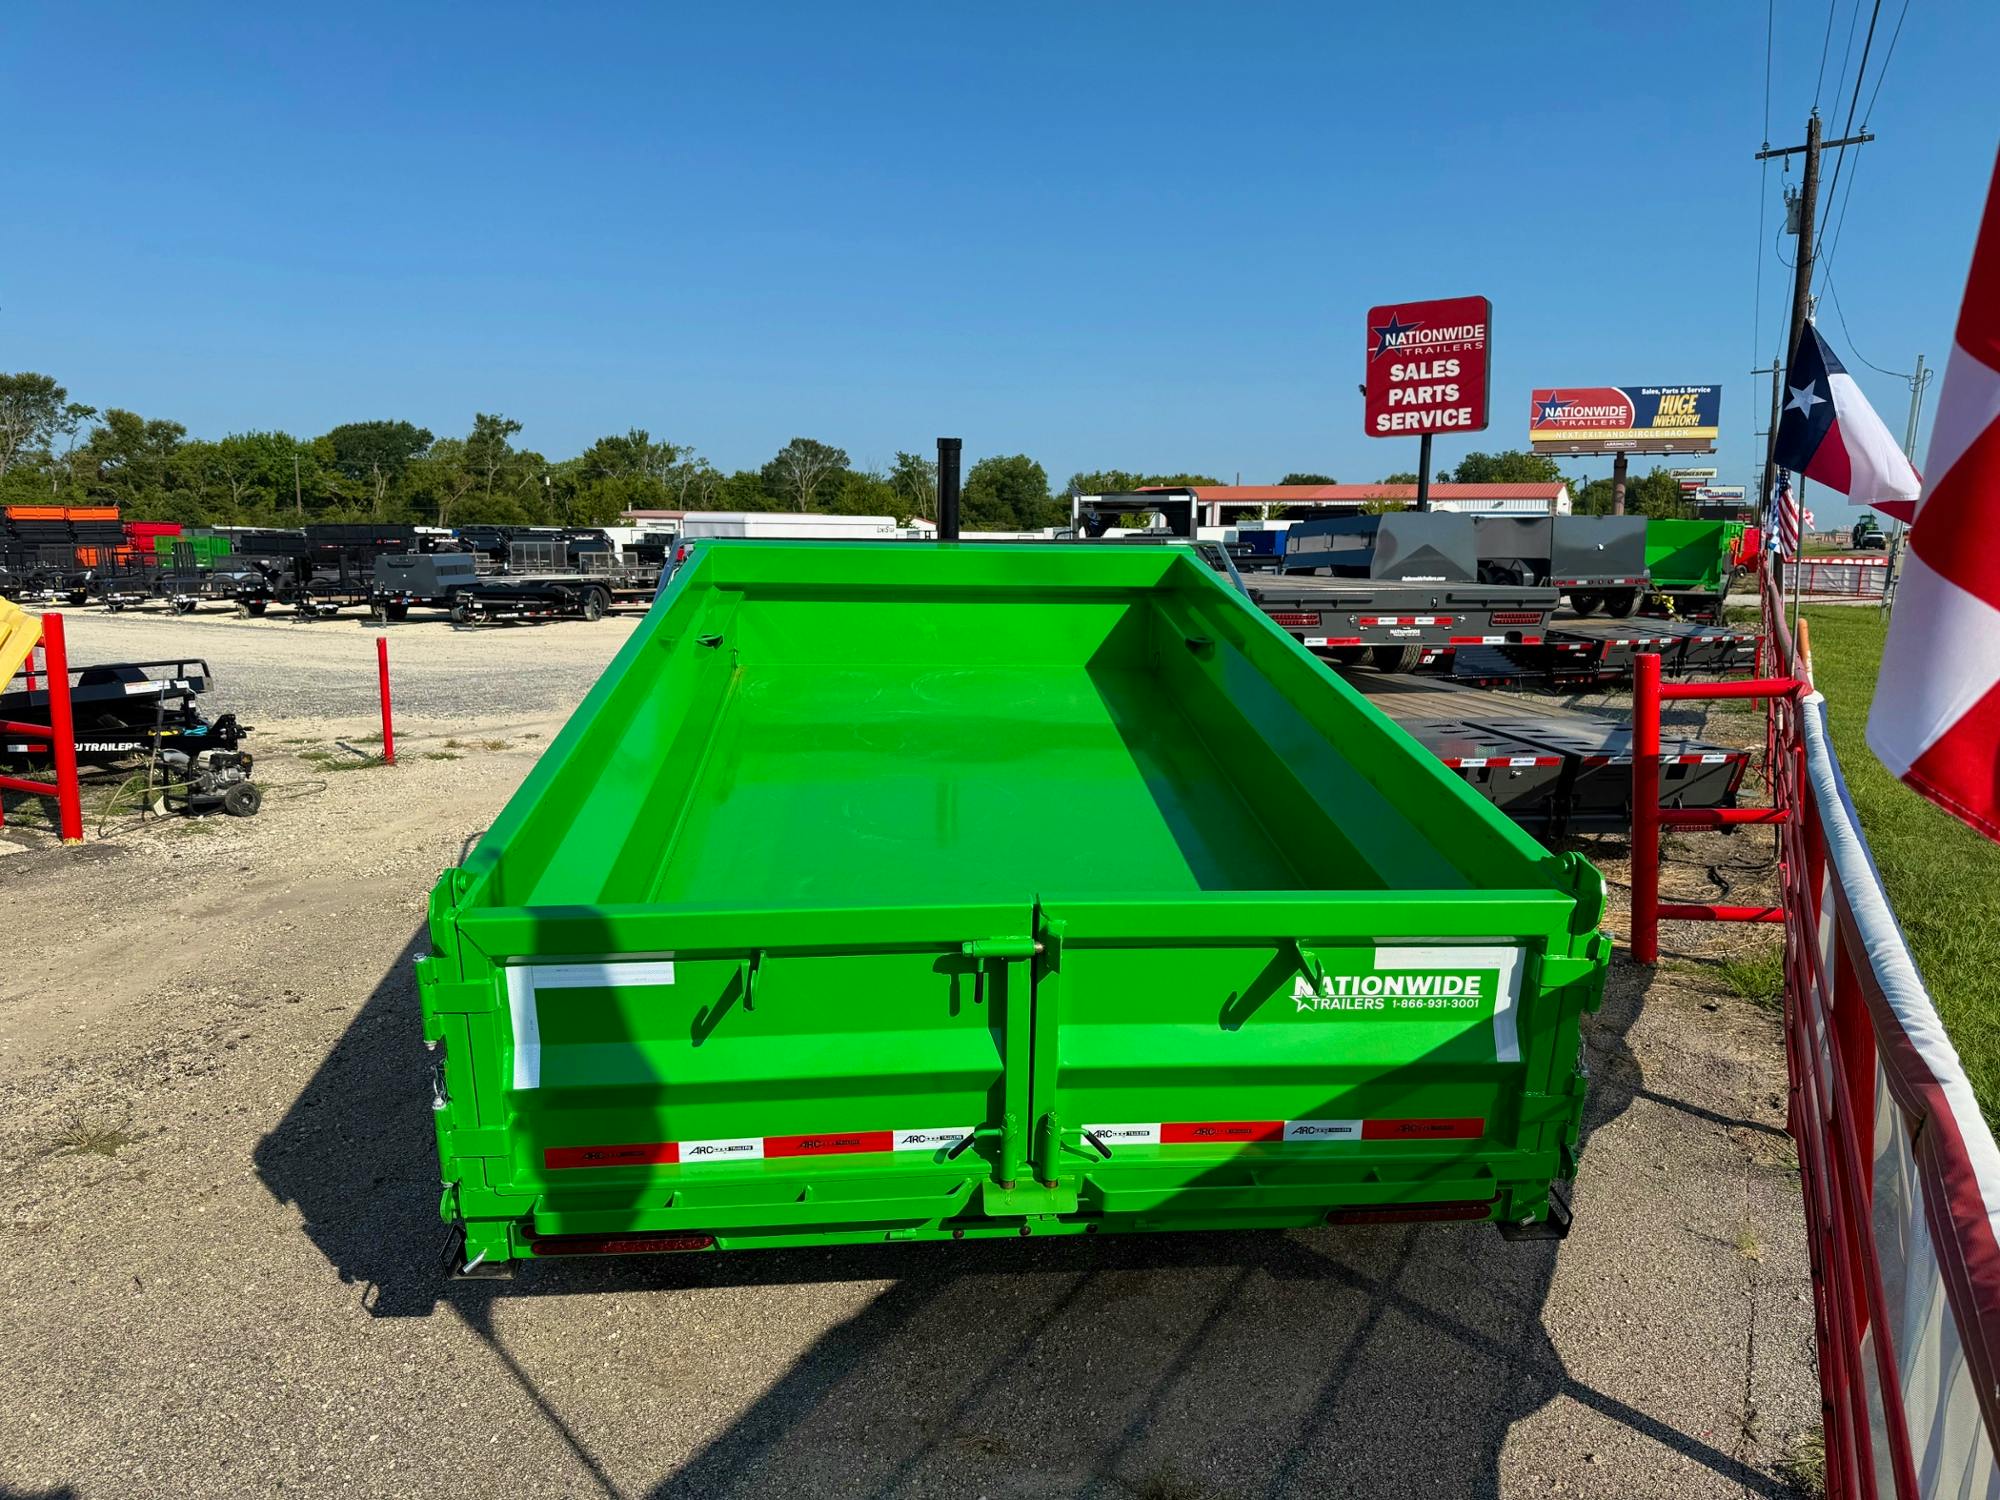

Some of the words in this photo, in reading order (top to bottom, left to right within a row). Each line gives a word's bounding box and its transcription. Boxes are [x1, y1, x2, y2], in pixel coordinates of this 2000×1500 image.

[1385, 324, 1485, 346] NATIONWIDE
[1404, 342, 1483, 356] TRAILERS
[1389, 359, 1460, 382] SALES
[1388, 384, 1460, 406] PARTS
[1545, 405, 1628, 417] NATIONWIDE
[1658, 394, 1699, 415] HUGE
[1376, 407, 1472, 432] SERVICE
[1560, 419, 1626, 427] TRAILERS
[1652, 414, 1701, 427] INVENTORY!
[1555, 431, 1578, 439] NEXT
[1604, 430, 1625, 438] AND
[1294, 975, 1482, 996] NATIONWIDE
[1312, 998, 1385, 1010] TRAILERS
[1393, 999, 1479, 1009] 1-866-931-3001
[1291, 1126, 1315, 1135] ARC
[901, 1134, 926, 1144] ARC
[689, 1146, 714, 1155] ARC
